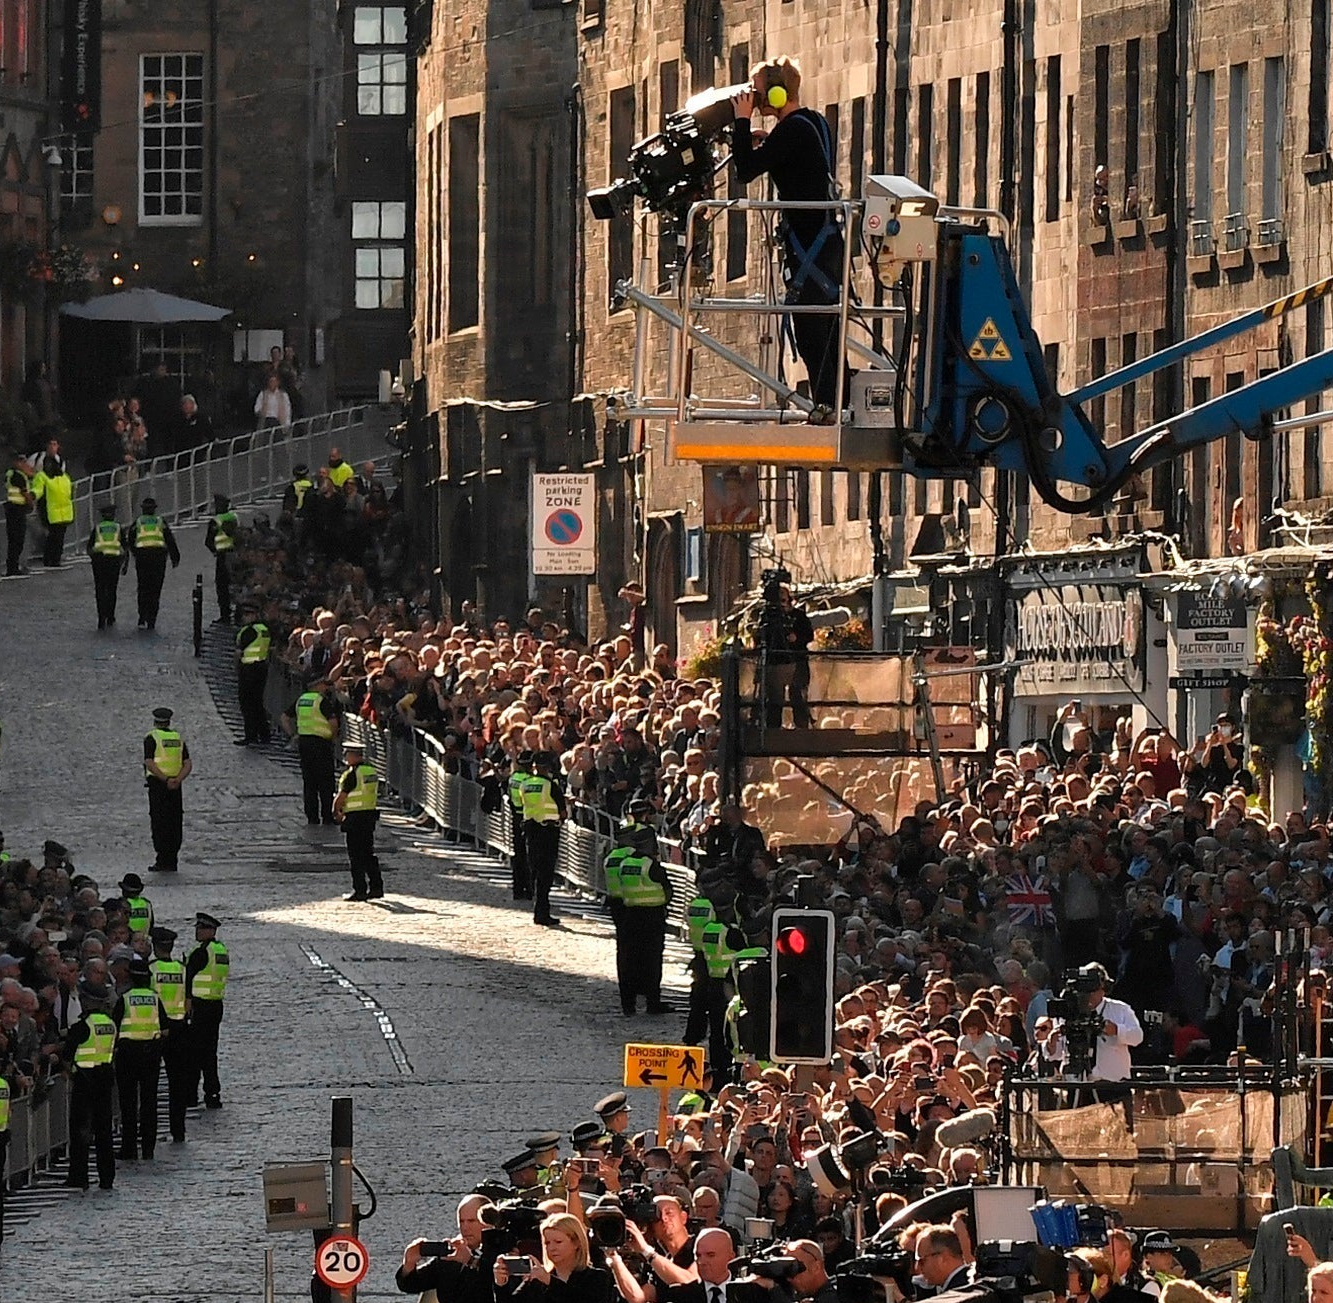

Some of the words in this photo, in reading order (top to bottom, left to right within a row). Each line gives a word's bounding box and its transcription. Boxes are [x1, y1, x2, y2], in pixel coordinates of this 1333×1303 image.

[75, 0, 89, 30] hisky
[76, 33, 88, 95] Experience
[539, 476, 589, 485] Restricted
[545, 486, 582, 496] parking
[546, 497, 581, 507] ZONE
[1197, 601, 1225, 609] MILE
[1188, 609, 1235, 618] FACTORY
[1190, 617, 1233, 626] OUTLET
[1179, 643, 1213, 654] FACTORY
[1215, 642, 1245, 653] OUTLET
[1177, 679, 1200, 687] GIFT
[1202, 679, 1229, 687] SHOP
[158, 974, 181, 983] POLICE
[130, 997, 155, 1005] POLICE
[628, 1048, 680, 1058] CROSSING
[639, 1059, 668, 1068] POINT
[325, 1252, 361, 1273] 20
